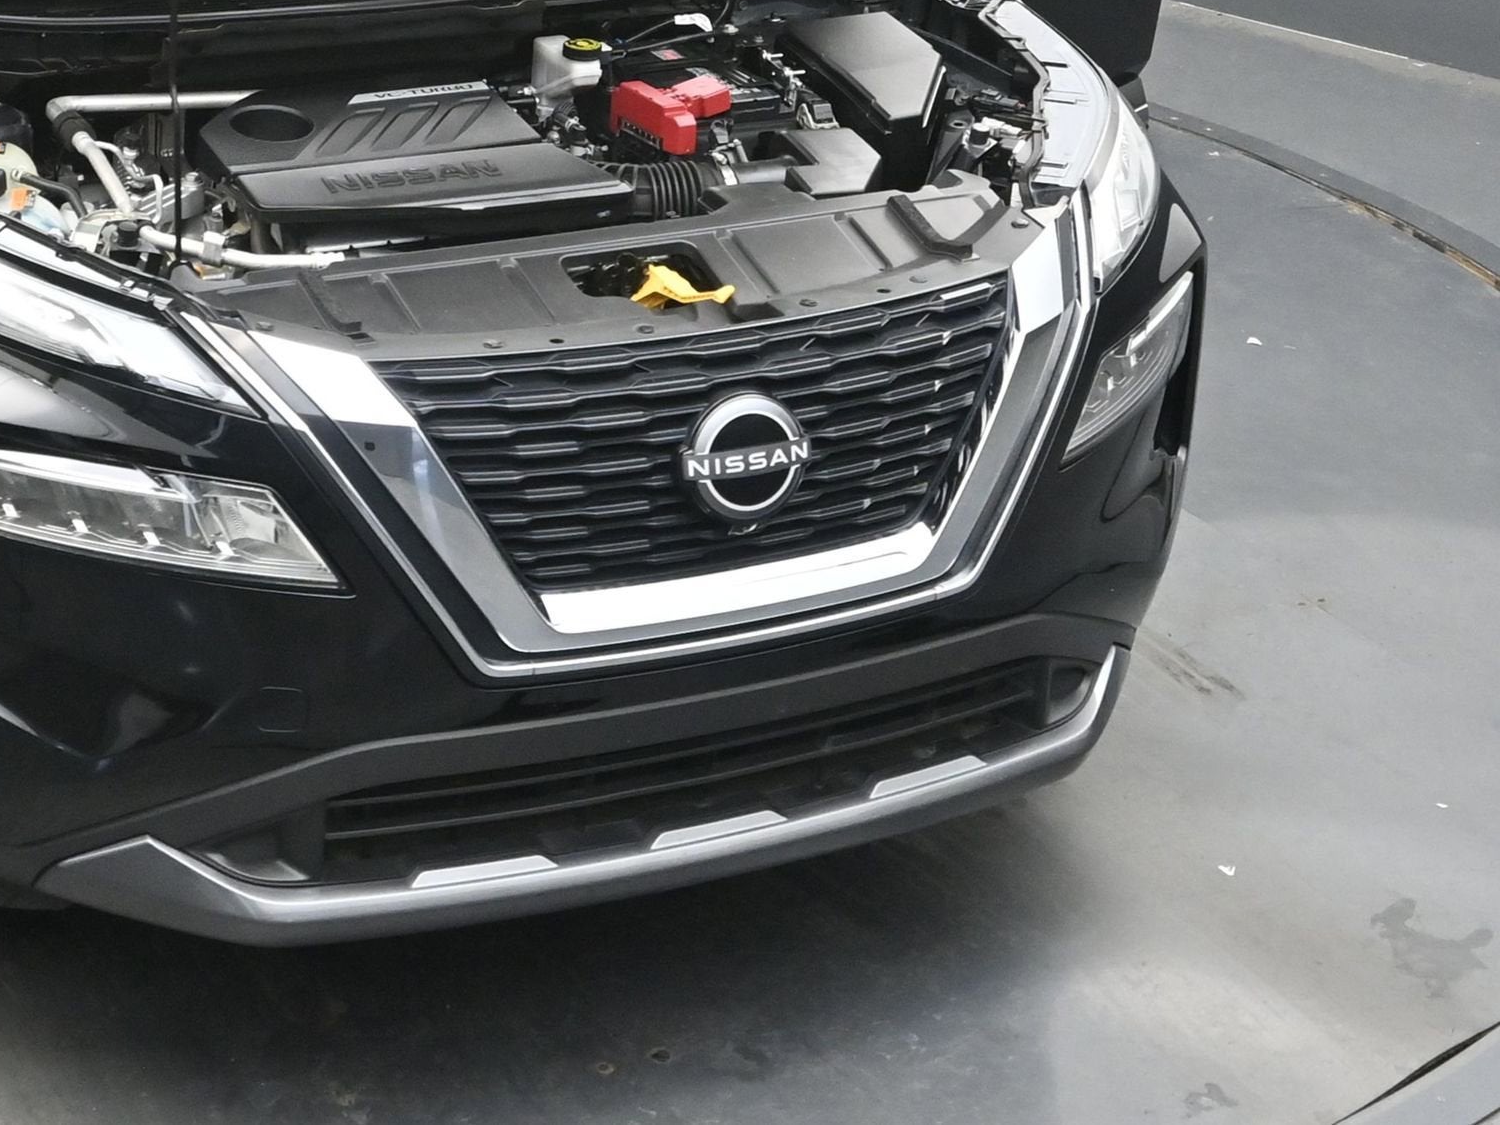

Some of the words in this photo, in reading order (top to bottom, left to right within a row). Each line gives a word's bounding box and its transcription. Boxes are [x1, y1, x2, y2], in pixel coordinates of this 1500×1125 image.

[373, 84, 474, 98] VC-TURBO
[320, 159, 503, 194] NISSAN
[687, 441, 809, 478] NISSAN
